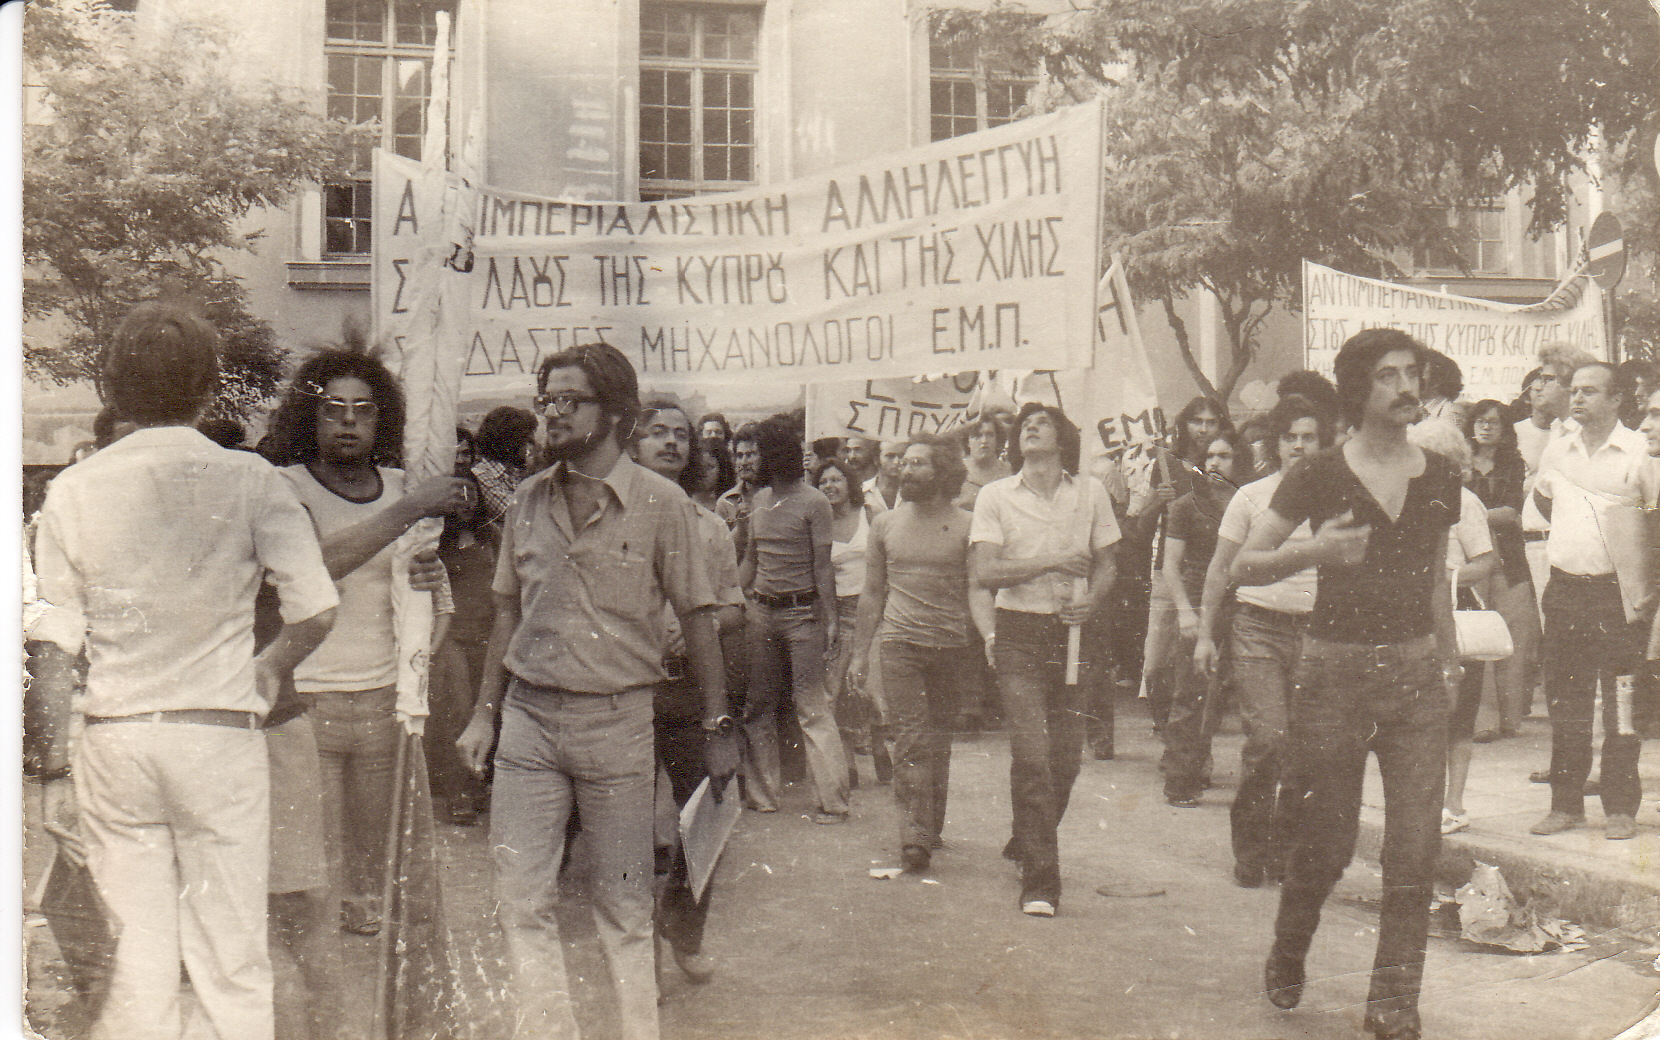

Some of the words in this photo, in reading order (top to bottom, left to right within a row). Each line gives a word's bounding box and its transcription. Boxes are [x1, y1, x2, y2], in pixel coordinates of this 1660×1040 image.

[821, 135, 1061, 233] ΑΛΛΗΛΕΓΓΥΗ
[594, 256, 650, 305] ΤΗΣ
[824, 240, 881, 299] ΚΑΙ
[892, 228, 960, 289] ΤΗΣ
[975, 217, 1065, 281] ΧΙΛΗΣ
[641, 314, 893, 373] ΜΗΧΑΝΟΛΟΓΟΙ
[1502, 323, 1528, 356] ΚΑΙ
